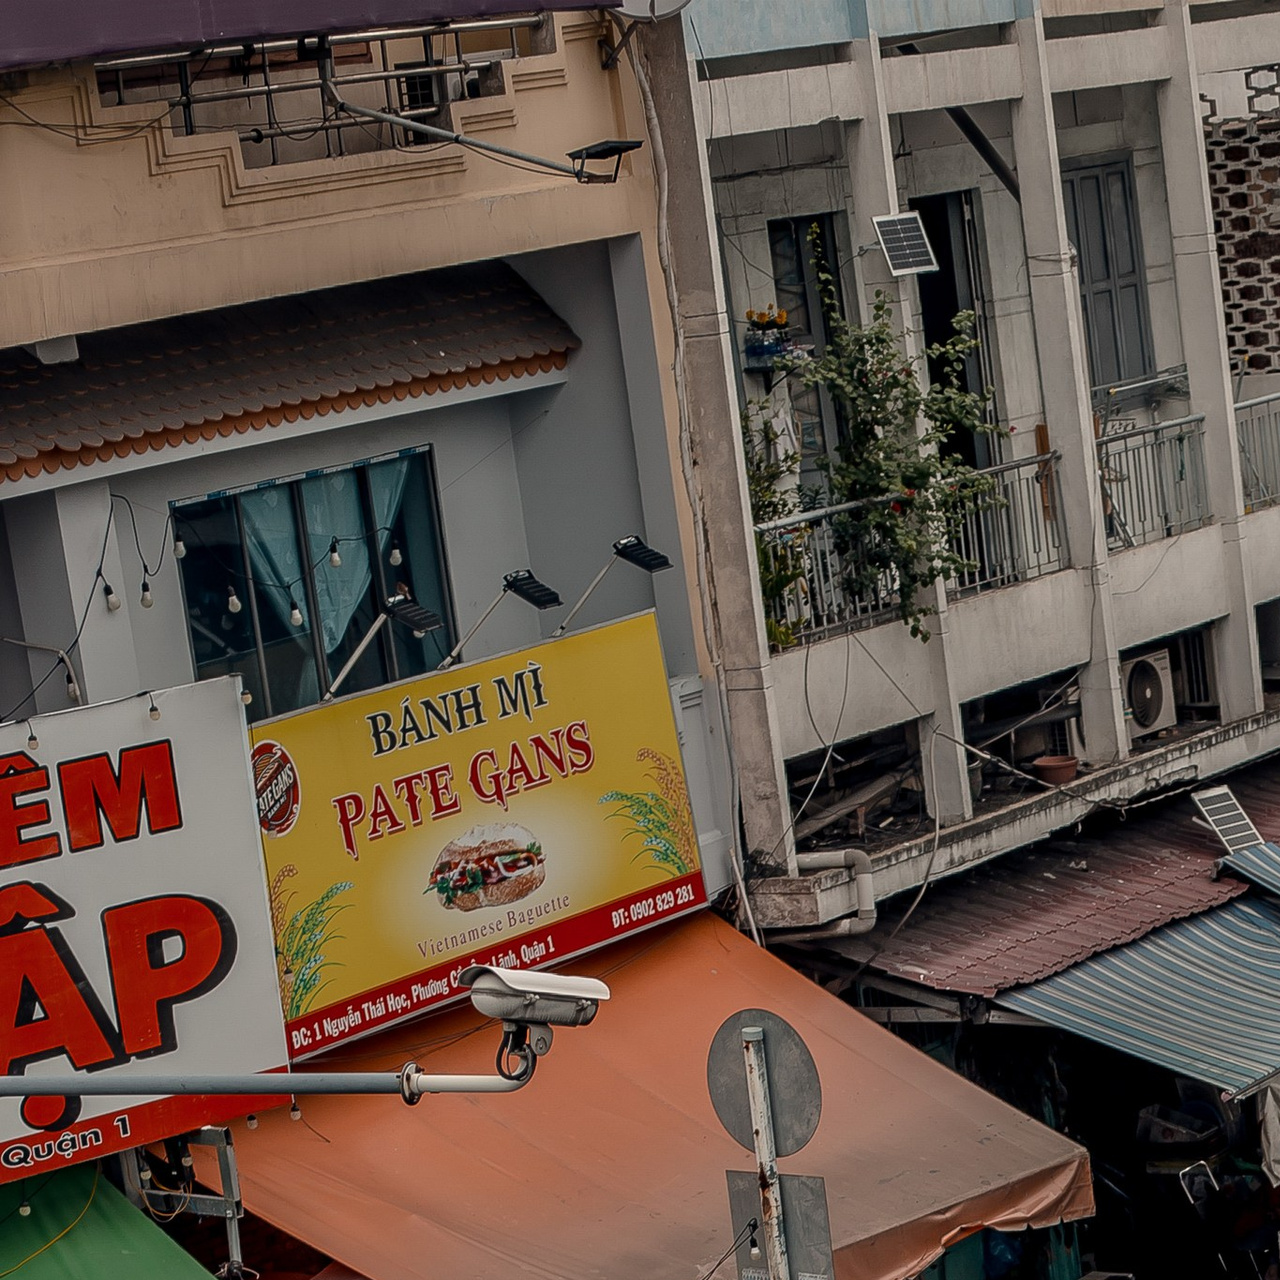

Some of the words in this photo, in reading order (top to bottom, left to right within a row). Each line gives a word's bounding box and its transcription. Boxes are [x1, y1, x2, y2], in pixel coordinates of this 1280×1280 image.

[365, 684, 487, 757] BÁNH
[494, 660, 549, 722] MÌ
[331, 763, 462, 861] PATE
[468, 721, 596, 812] GANS
[417, 923, 504, 959] Vietnamese
[506, 893, 572, 929] Baguette
[611, 909, 630, 930] ĐT:
[629, 901, 656, 922] 0902
[655, 891, 675, 914] 829
[674, 883, 696, 907] 281
[291, 1026, 313, 1050] ĐC:
[313, 1021, 323, 1042] 1
[322, 1005, 362, 1037] Nguyễn
[361, 993, 386, 1022] Thái
[386, 989, 411, 1019] Học,
[410, 974, 450, 1004] Phường
[520, 940, 547, 965] Quận
[546, 934, 556, 953] 1
[1, 1125, 102, 1169] Quận
[113, 1114, 132, 1138] 1
